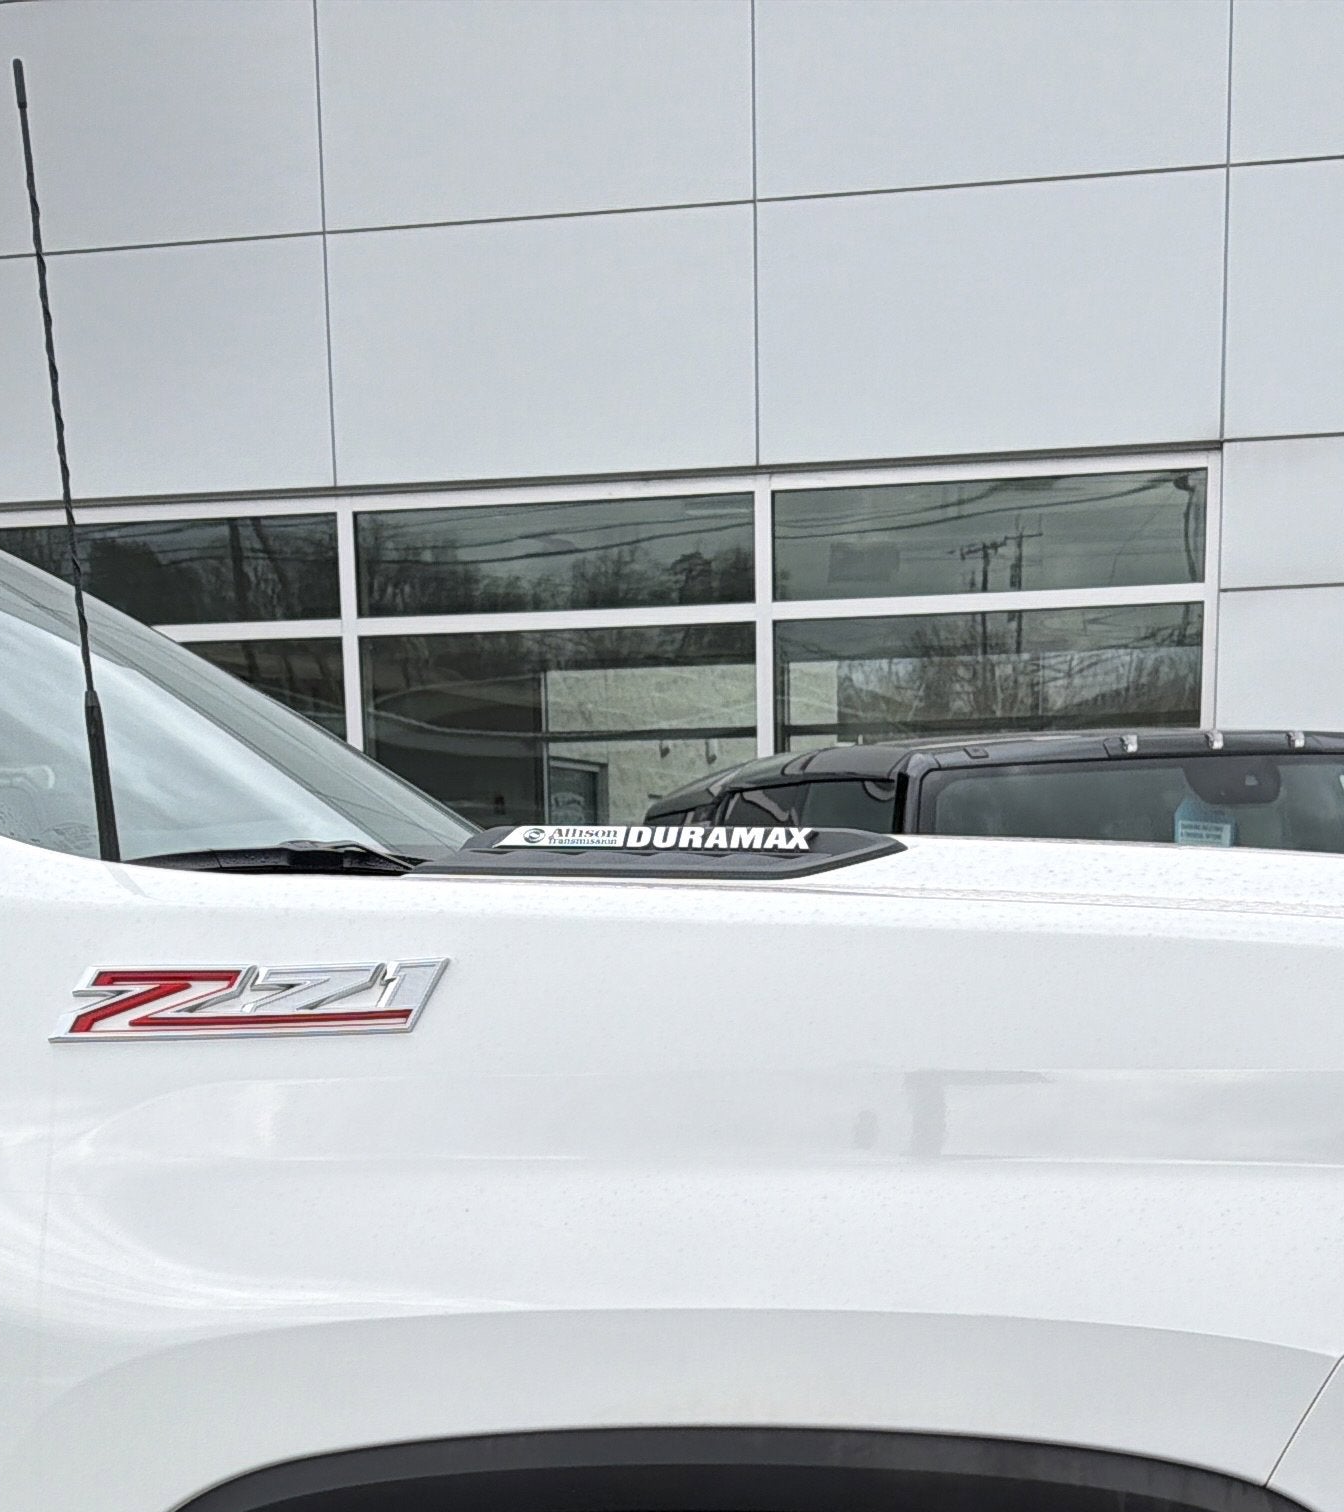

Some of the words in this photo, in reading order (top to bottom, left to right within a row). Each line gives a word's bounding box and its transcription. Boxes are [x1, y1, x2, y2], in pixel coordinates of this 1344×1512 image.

[548, 827, 618, 838] Allison
[626, 826, 815, 850] DURAMAX
[48, 957, 450, 1043] Z71
